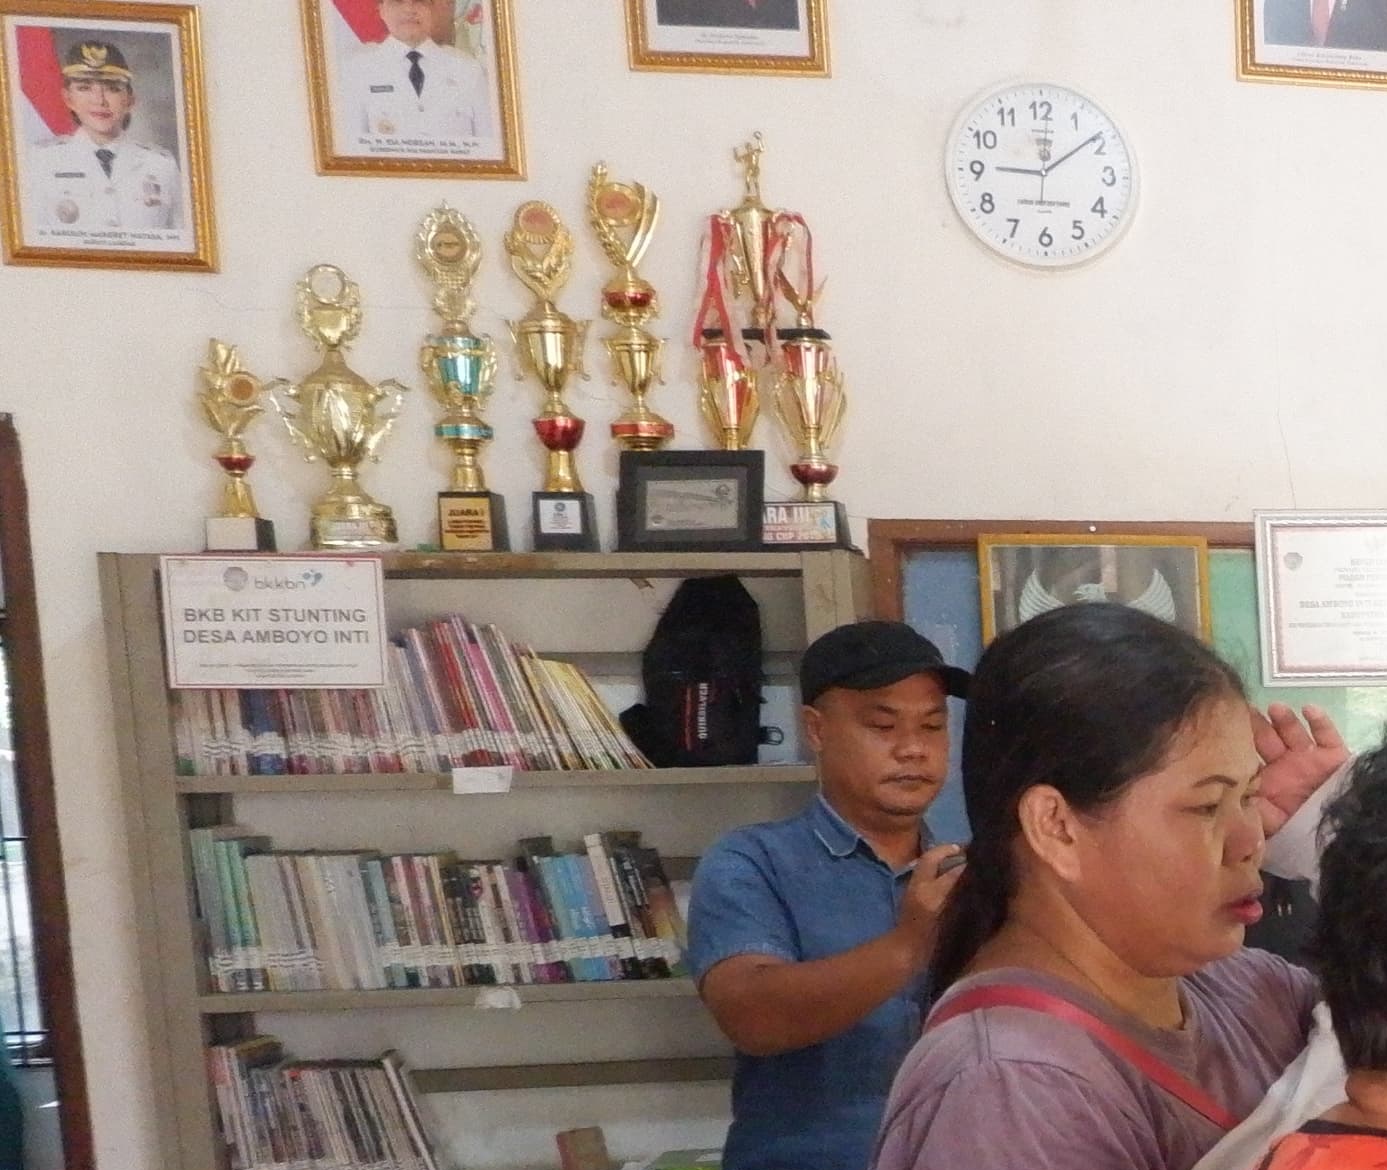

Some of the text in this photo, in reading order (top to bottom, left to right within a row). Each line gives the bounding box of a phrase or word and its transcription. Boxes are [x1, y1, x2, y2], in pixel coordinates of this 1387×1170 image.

[997, 107, 1079, 131] 11 1
[1029, 101, 1053, 121] 12
[973, 130, 1106, 155] 10 2
[970, 160, 1116, 186] 9 3
[980, 193, 995, 214] 8
[1091, 196, 1108, 218] 4
[1006, 218, 1085, 240] 7 5
[1038, 226, 1053, 247] 6
[254, 576, 305, 589] bkkbn
[184, 608, 366, 622] BKB KIT STUNTING
[184, 630, 369, 644] DESA AMBOYO INTI
